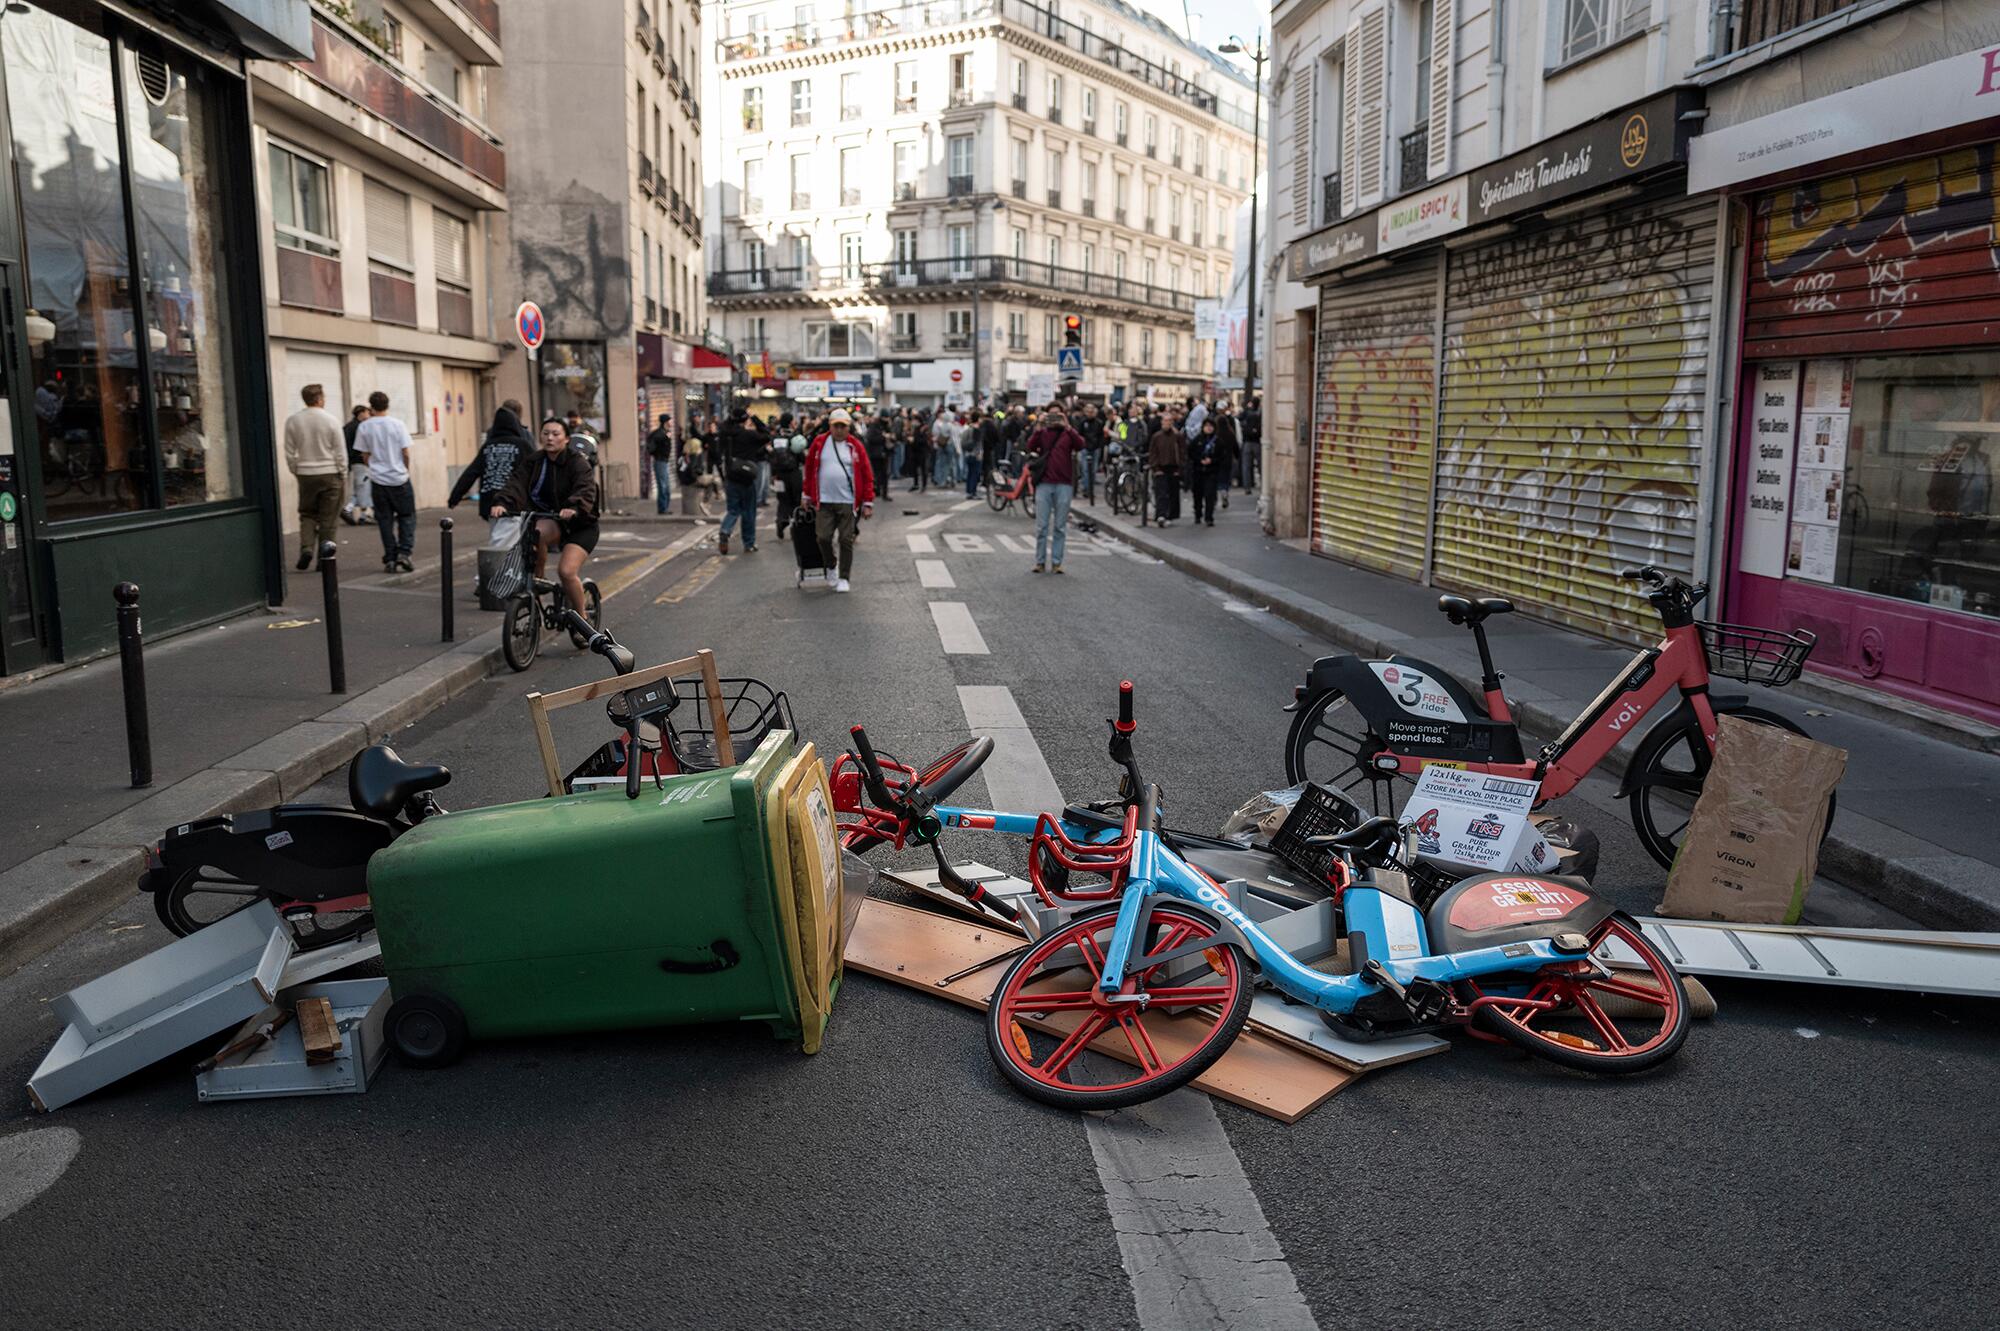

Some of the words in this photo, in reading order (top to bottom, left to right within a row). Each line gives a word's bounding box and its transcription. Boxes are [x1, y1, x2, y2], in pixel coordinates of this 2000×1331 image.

[1536, 145, 1592, 192] Tandoori
[1391, 207, 1419, 230] INDIAN
[1420, 193, 1449, 221] SPICY
[941, 533, 1112, 556] BUS
[1397, 672, 1424, 707] 3
[1423, 693, 1449, 706] FREE
[1421, 702, 1446, 714] rides
[1608, 702, 1642, 731] voi.
[1389, 722, 1416, 732] Move
[1388, 733, 1420, 743] spend
[1422, 734, 1445, 744] less.
[1430, 769, 1462, 782] 12x1kg
[1425, 783, 1448, 792] STORE
[1464, 790, 1483, 798] COOL
[1500, 796, 1522, 805] PLACE
[1471, 820, 1503, 836] TRS
[1451, 841, 1474, 851] GRAM
[1475, 846, 1501, 857] FLOUR
[1469, 838, 1488, 847] PURE
[1453, 849, 1476, 859] 12x1kg
[1491, 882, 1547, 895] ESSAI
[1491, 892, 1562, 907] GRUIT
